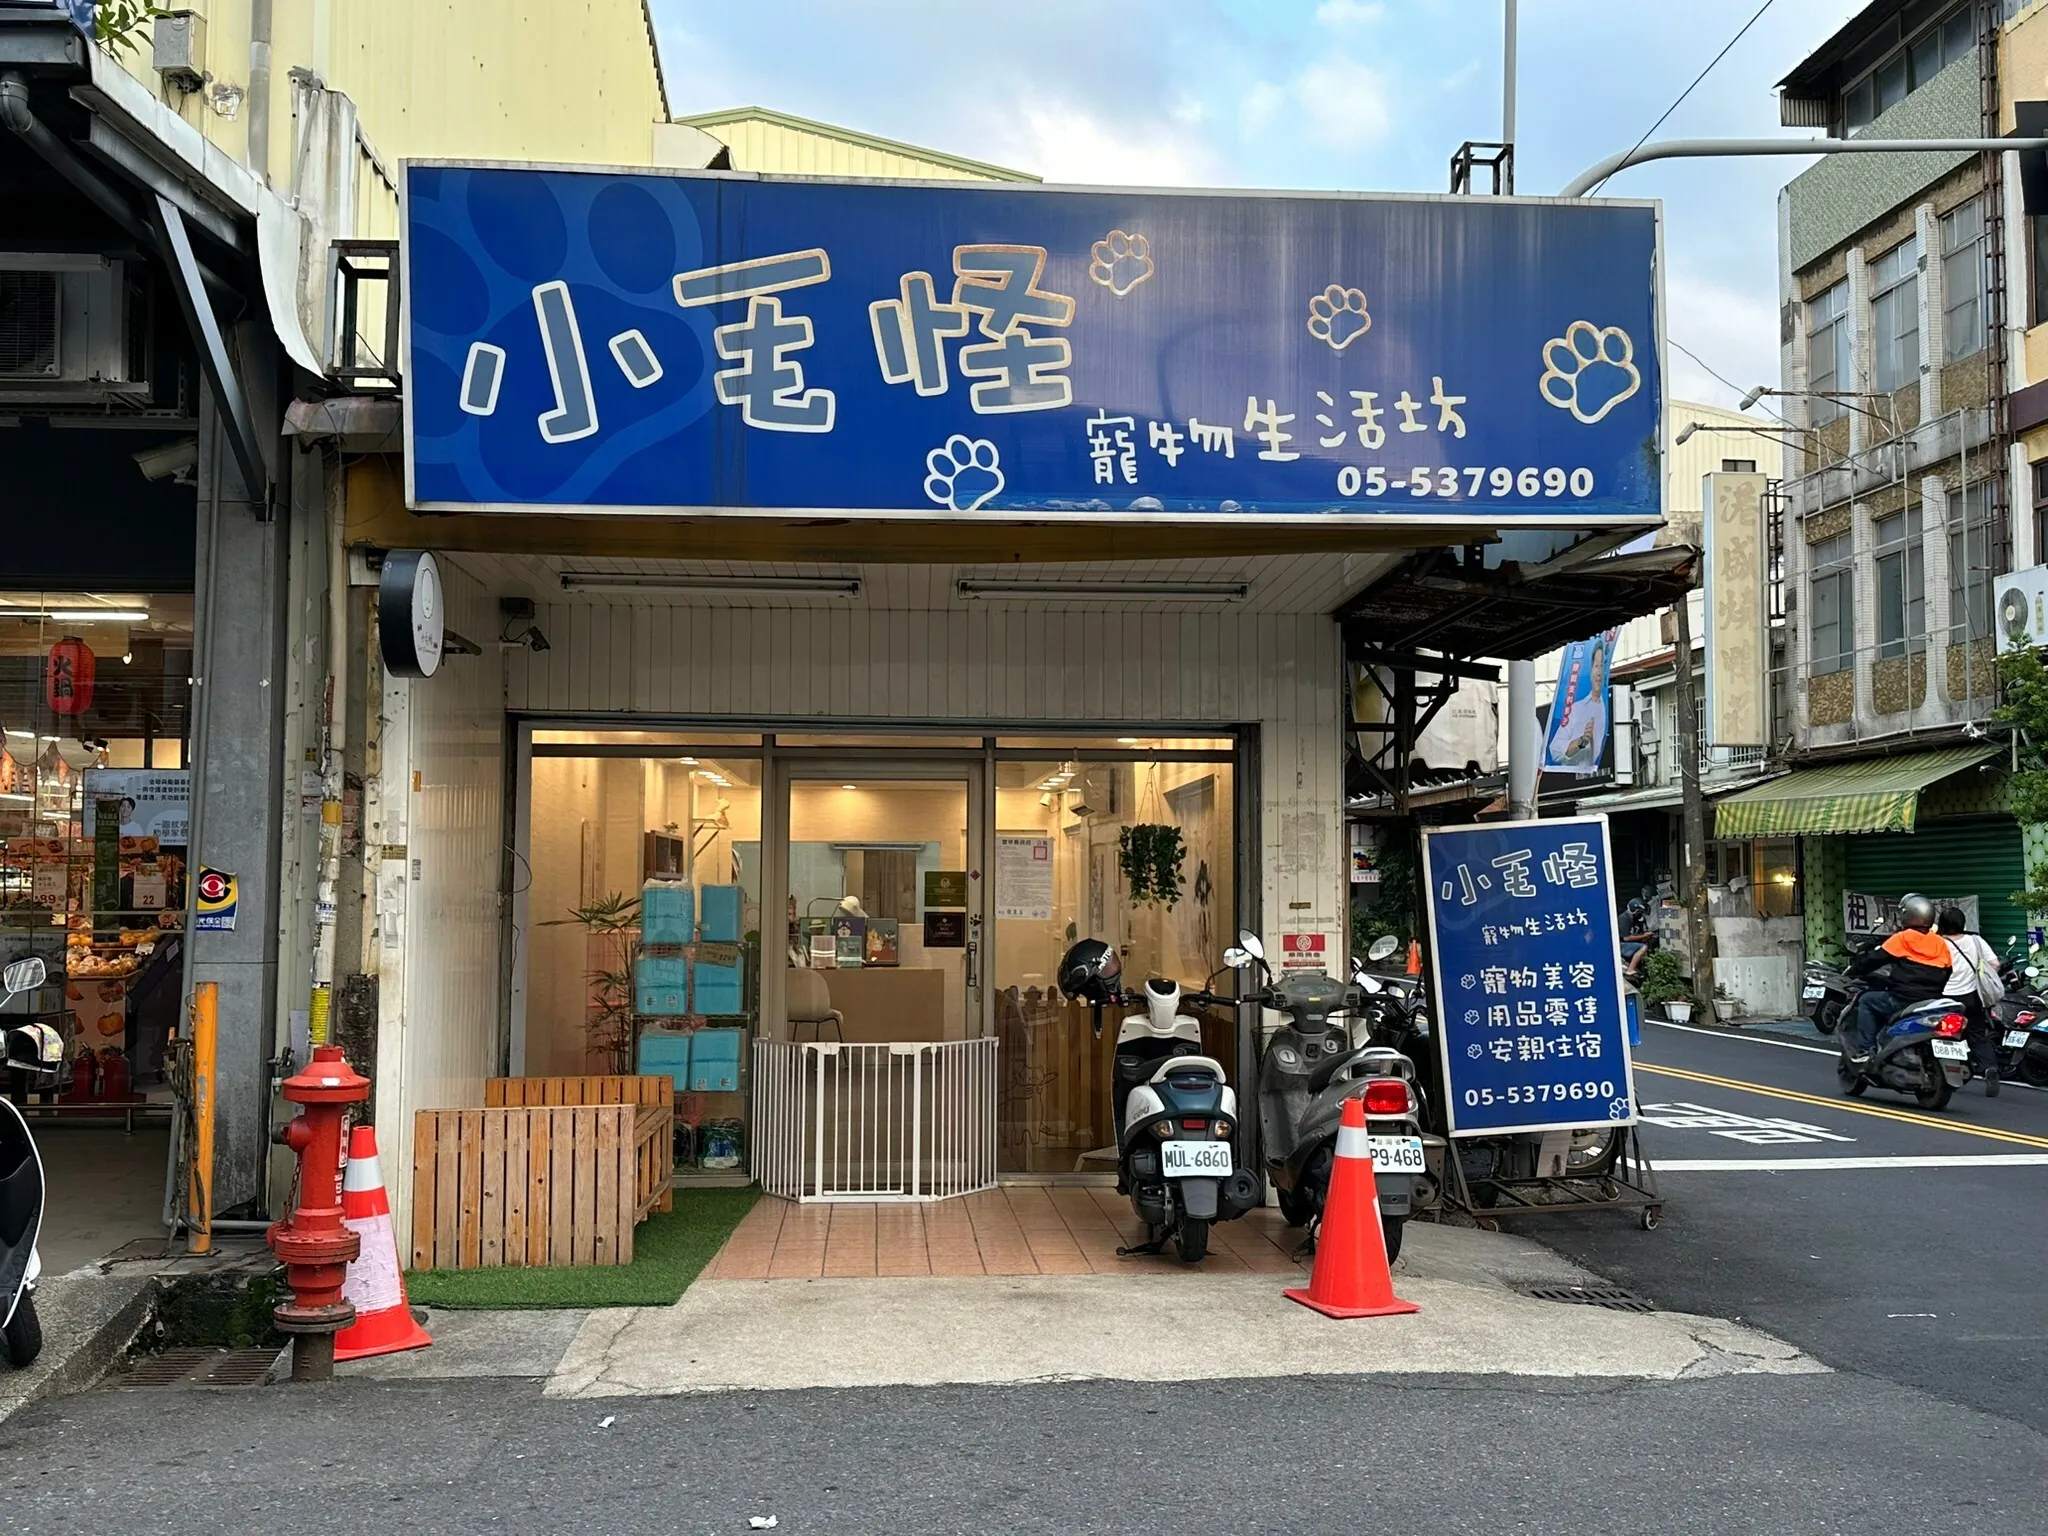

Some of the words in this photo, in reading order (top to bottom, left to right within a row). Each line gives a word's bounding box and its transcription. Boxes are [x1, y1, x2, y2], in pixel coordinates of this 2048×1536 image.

[458, 243, 1076, 444] 小毛怪
[1086, 376, 1467, 485] 寵物生活坊
[1336, 466, 1594, 498] 05-5379690
[53, 655, 73, 698] 火鍋
[1441, 842, 1600, 906] 小毛怪
[142, 895, 155, 905] 22
[1481, 909, 1589, 945] 寵物生活坊
[1479, 961, 1596, 995] 寵物美容
[1487, 996, 1599, 1028] 用品零售
[1488, 1031, 1602, 1062] 安親住宿
[1464, 1080, 1615, 1107] 05-5379690
